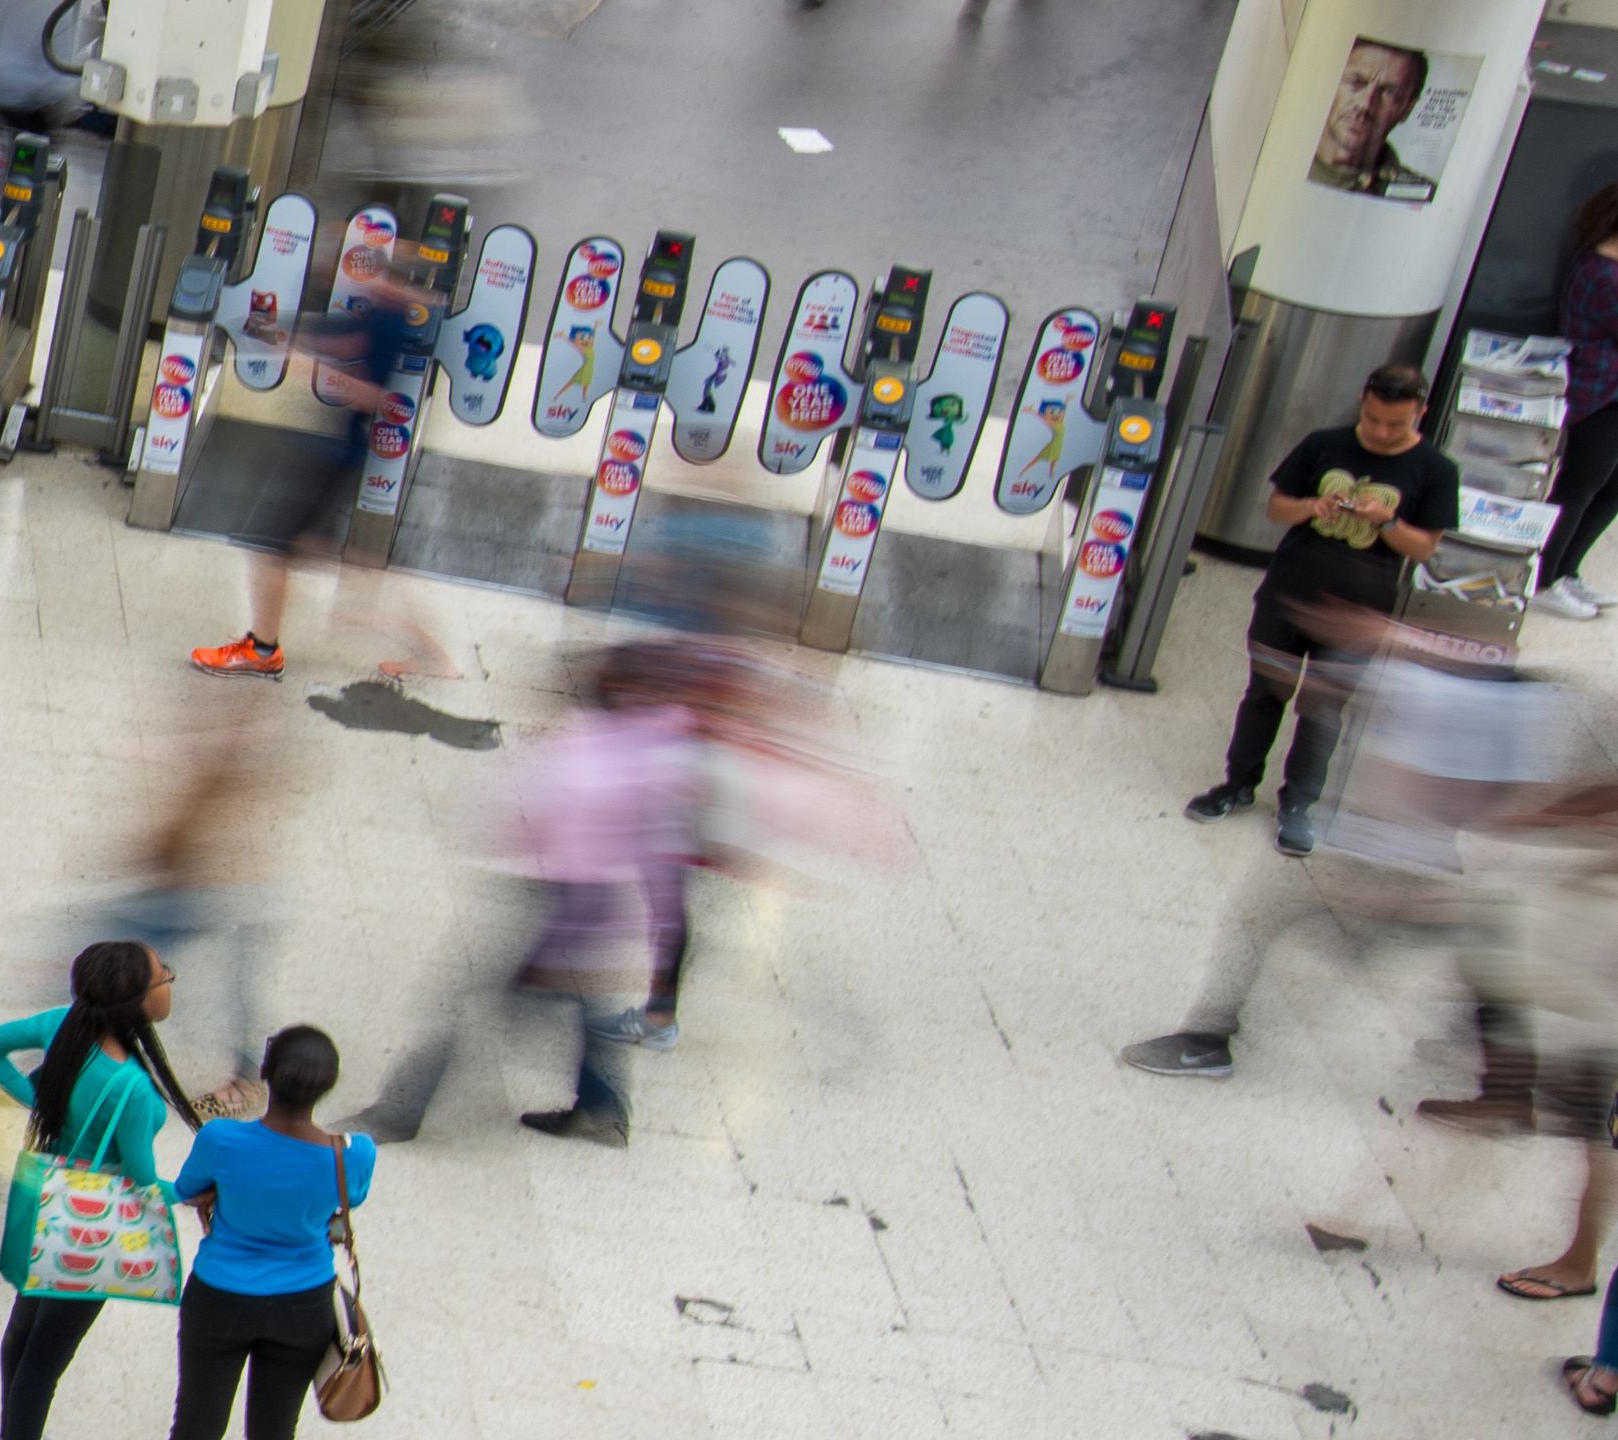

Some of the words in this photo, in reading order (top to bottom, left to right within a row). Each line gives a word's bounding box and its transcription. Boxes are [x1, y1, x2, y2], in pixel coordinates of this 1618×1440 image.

[793, 384, 830, 398] ONE
[789, 395, 833, 411] YEAR
[790, 409, 830, 422] FREE
[377, 427, 400, 437] ONE
[151, 434, 178, 453] sky
[375, 436, 403, 446] YEAR
[376, 444, 402, 453] FREE
[774, 438, 808, 459] sky
[367, 474, 397, 493] sky
[595, 512, 625, 531] sky
